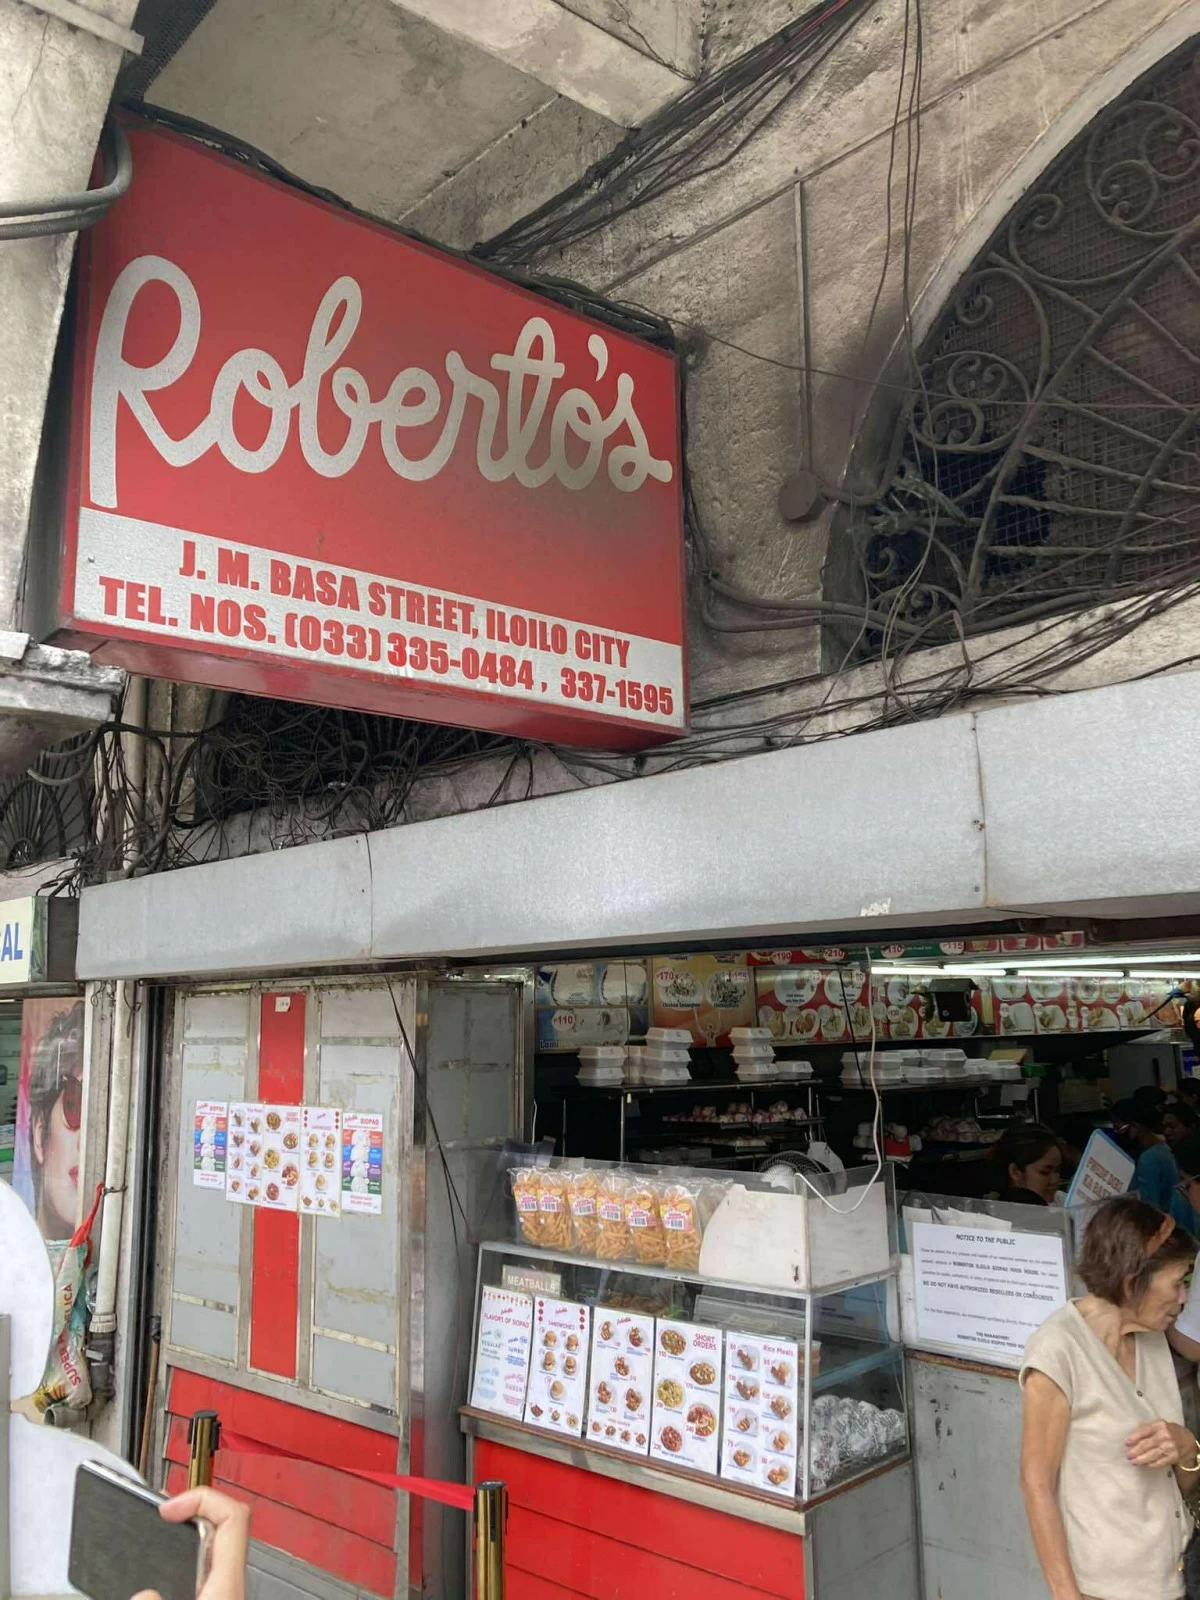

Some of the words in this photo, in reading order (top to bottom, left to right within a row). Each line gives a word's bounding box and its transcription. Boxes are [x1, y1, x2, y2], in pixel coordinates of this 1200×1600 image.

[90, 254, 673, 508] Roberto's
[179, 540, 206, 580] J.
[217, 547, 260, 590] M.
[270, 559, 360, 611] BASA
[368, 582, 478, 640] STREET,
[486, 609, 567, 654] ILOILO
[575, 629, 630, 668] CITY
[99, 576, 178, 627] TEL.
[190, 593, 276, 643] NOS.
[284, 612, 381, 662] (033)
[387, 632, 534, 691] 335-0484
[560, 667, 674, 715] 337-1595
[0, 922, 23, 961] AL
[956, 1234, 975, 1242] NOTICE
[984, 1236, 996, 1244] THE
[996, 1237, 1016, 1246] PUBLIC
[507, 1274, 556, 1293] MEATBALLS
[960, 1284, 989, 1293] AUTHORIZED
[692, 1340, 717, 1350] ORDERS
[695, 1333, 715, 1343] SHORT
[763, 1345, 775, 1353] Rice
[776, 1347, 793, 1357] Meals
[59, 1347, 82, 1386] SUPER
